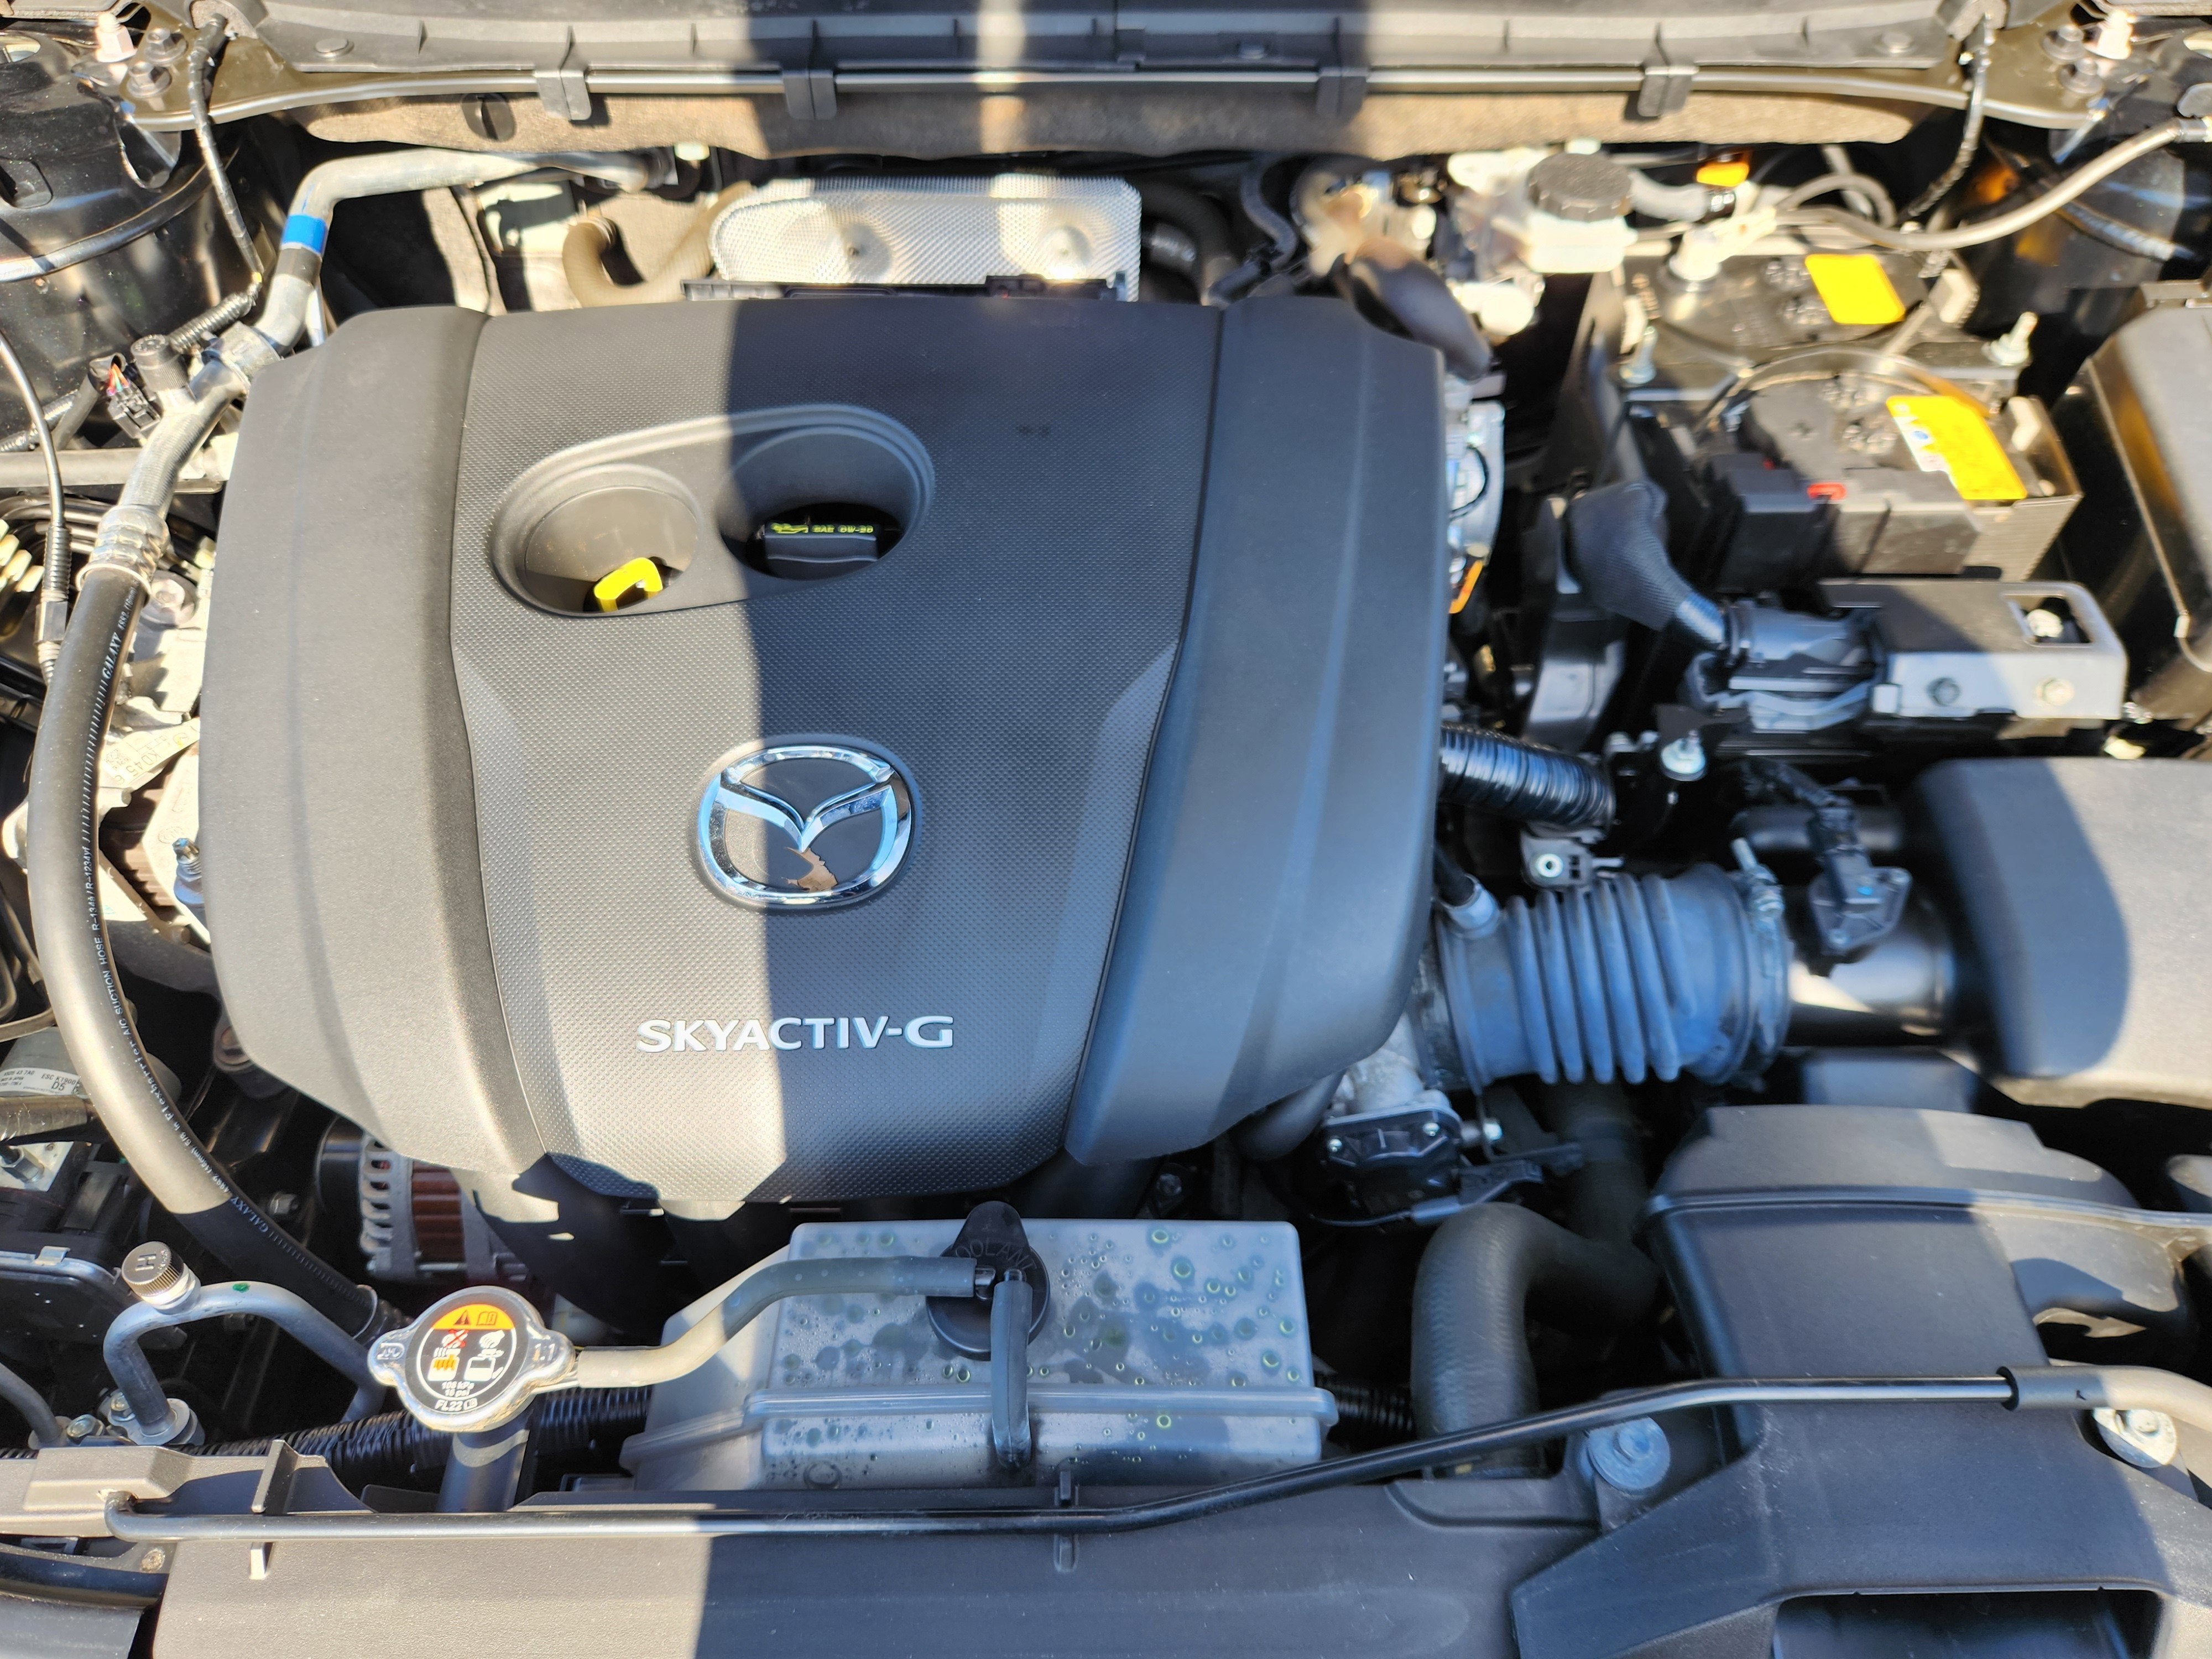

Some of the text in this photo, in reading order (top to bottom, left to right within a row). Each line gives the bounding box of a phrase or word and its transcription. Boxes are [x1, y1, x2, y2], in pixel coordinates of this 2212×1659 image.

[812, 525, 874, 533] SAE 0W-20
[102, 632, 122, 679] GALAXY
[94, 937, 108, 965] HOSE
[103, 970, 123, 1015] SUCTION
[119, 1018, 131, 1036] A/C
[638, 1016, 954, 1053] SKYACTIV-G
[51, 1082, 66, 1091] D5
[129, 1040, 175, 1121] Flexbarrier
[230, 1197, 269, 1233] GALAXY
[135, 1254, 156, 1271] H
[956, 1238, 1037, 1270] OOLANT
[435, 1399, 463, 1411] FL22
